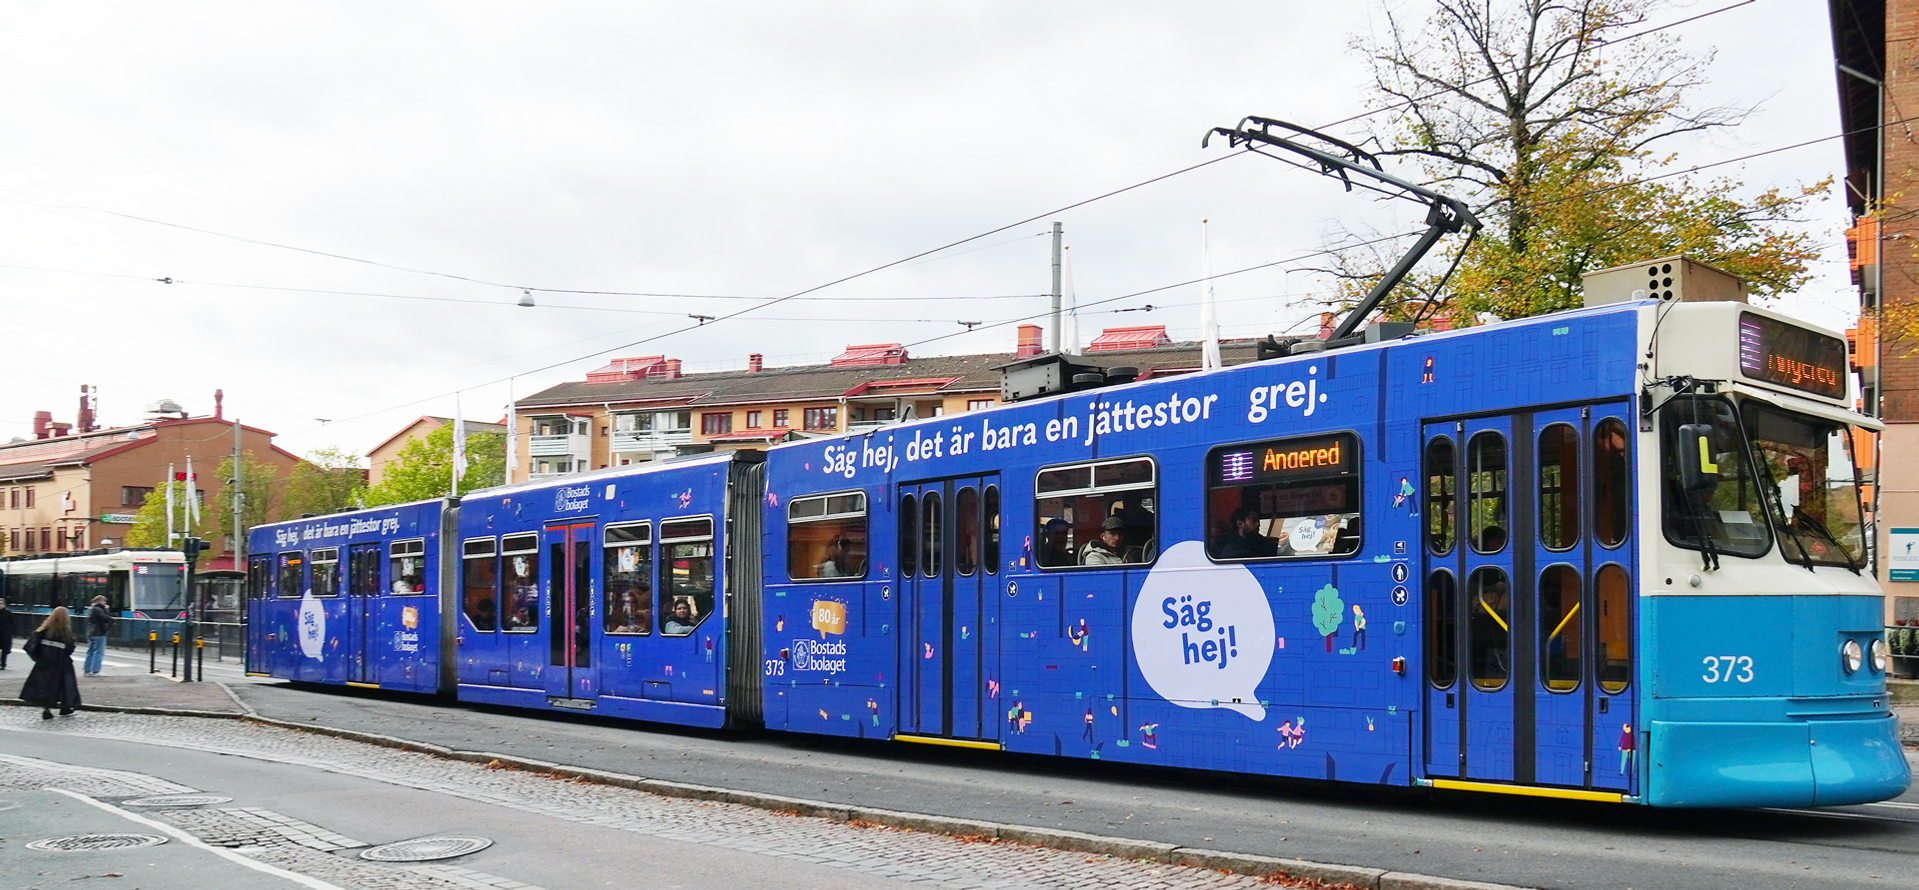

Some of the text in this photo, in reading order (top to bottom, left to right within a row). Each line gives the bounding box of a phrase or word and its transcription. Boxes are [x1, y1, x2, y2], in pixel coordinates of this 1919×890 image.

[823, 365, 1328, 479] Säg hej, det är bara en jättestor grej.
[566, 484, 590, 498] Bostads
[565, 498, 589, 513] bolaget
[275, 529, 287, 547] Säg
[303, 524, 315, 540] det
[315, 524, 323, 539] är
[323, 522, 339, 538] bara
[340, 524, 349, 536] en
[348, 517, 382, 539] jättestor
[818, 608, 840, 625] 80 år
[1161, 594, 1213, 632] Säg
[810, 639, 846, 655] Bostads
[1182, 625, 1237, 670] hej!
[765, 659, 784, 676] 373
[810, 655, 846, 675] bolaget
[1702, 655, 1754, 683] 373
